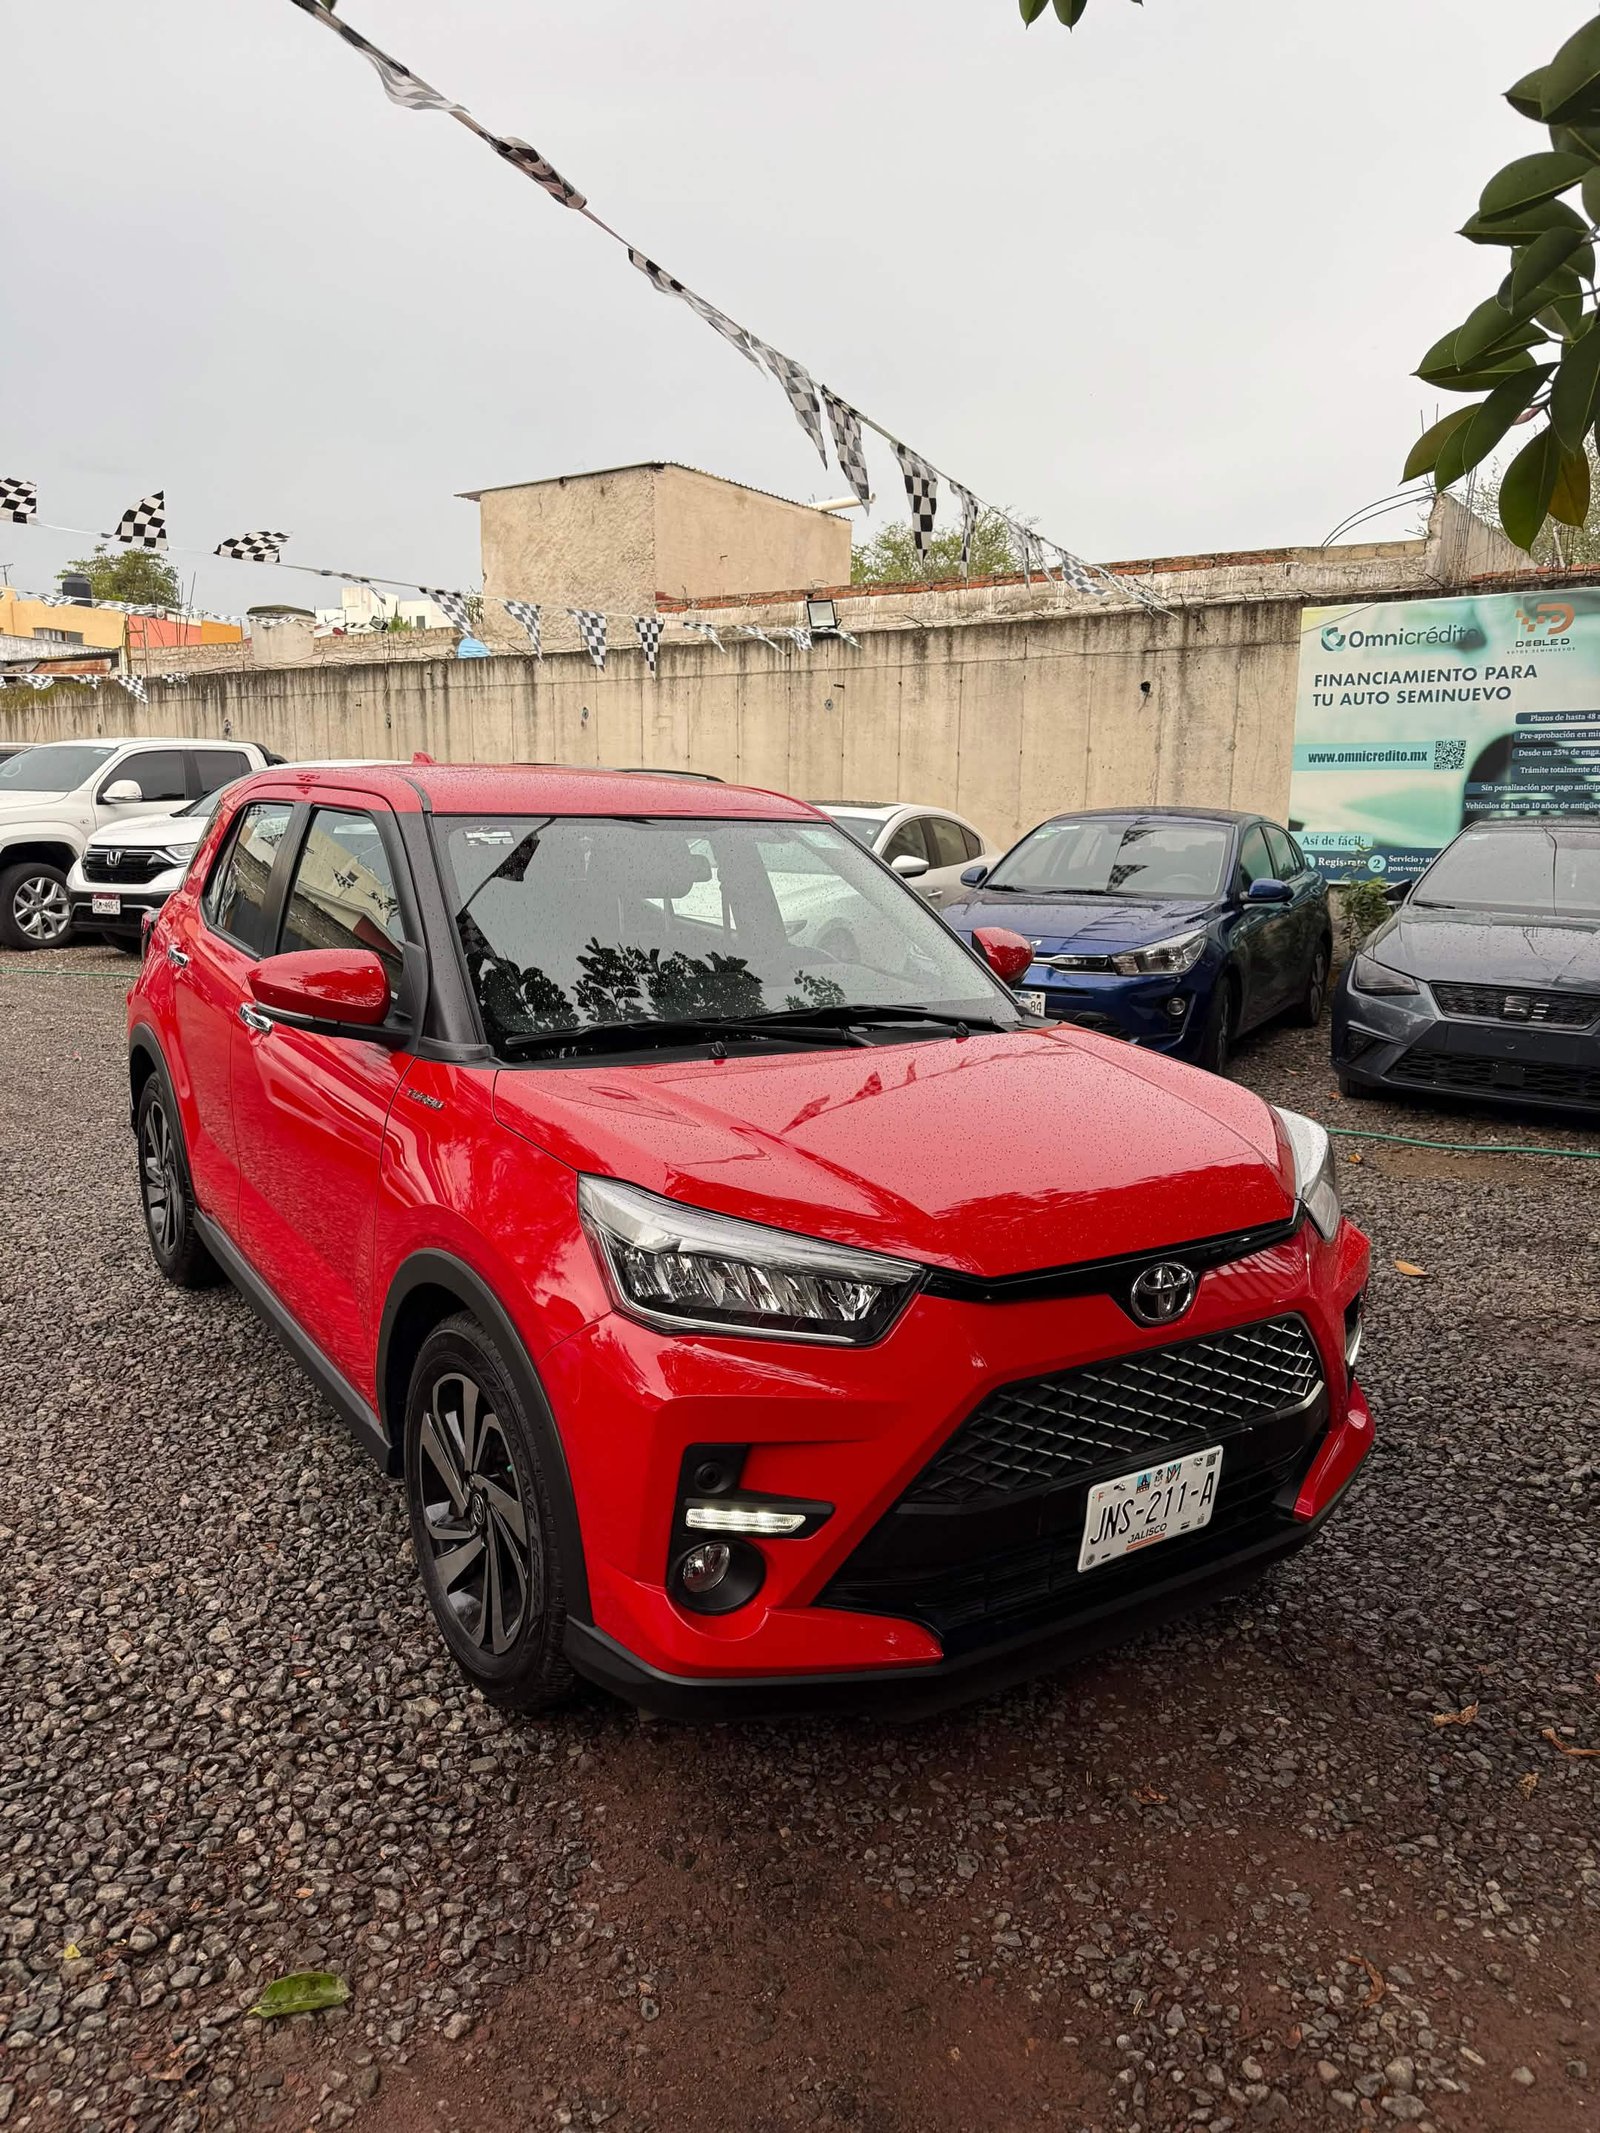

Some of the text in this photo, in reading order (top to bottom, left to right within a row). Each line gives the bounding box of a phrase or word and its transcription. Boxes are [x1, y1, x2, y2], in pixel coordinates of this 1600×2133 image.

[1349, 625, 1478, 648] Omnicrédito
[1314, 664, 1538, 687] FINANCIAMIENTO PARA
[1313, 686, 1512, 706] TU AUTO SEMINUEVO
[1530, 714, 1554, 722] Plazos
[1565, 713, 1585, 721] hasta
[1308, 750, 1428, 763] www.omnicredito.mx
[1518, 749, 1541, 757] Desde
[1541, 749, 1552, 757] un
[1570, 748, 1580, 756] de
[1520, 766, 1549, 774] Trámite
[1550, 765, 1591, 773] totalmente
[1481, 783, 1493, 791] Sin
[1494, 783, 1540, 793] penalización
[1540, 784, 1554, 792] por
[1554, 784, 1573, 793] pago
[1465, 801, 1499, 809] Vehículos
[1500, 801, 1510, 809] de
[1511, 801, 1530, 809] hasta
[1541, 801, 1558, 809] años
[1559, 801, 1569, 809] de
[1302, 835, 1319, 845] Así
[1320, 835, 1335, 845] de
[1388, 855, 1418, 863] Servicio
[1373, 860, 1381, 869] 2
[1089, 1471, 1215, 1545] JNS-211-A
[1127, 1522, 1168, 1544] JALISCO
